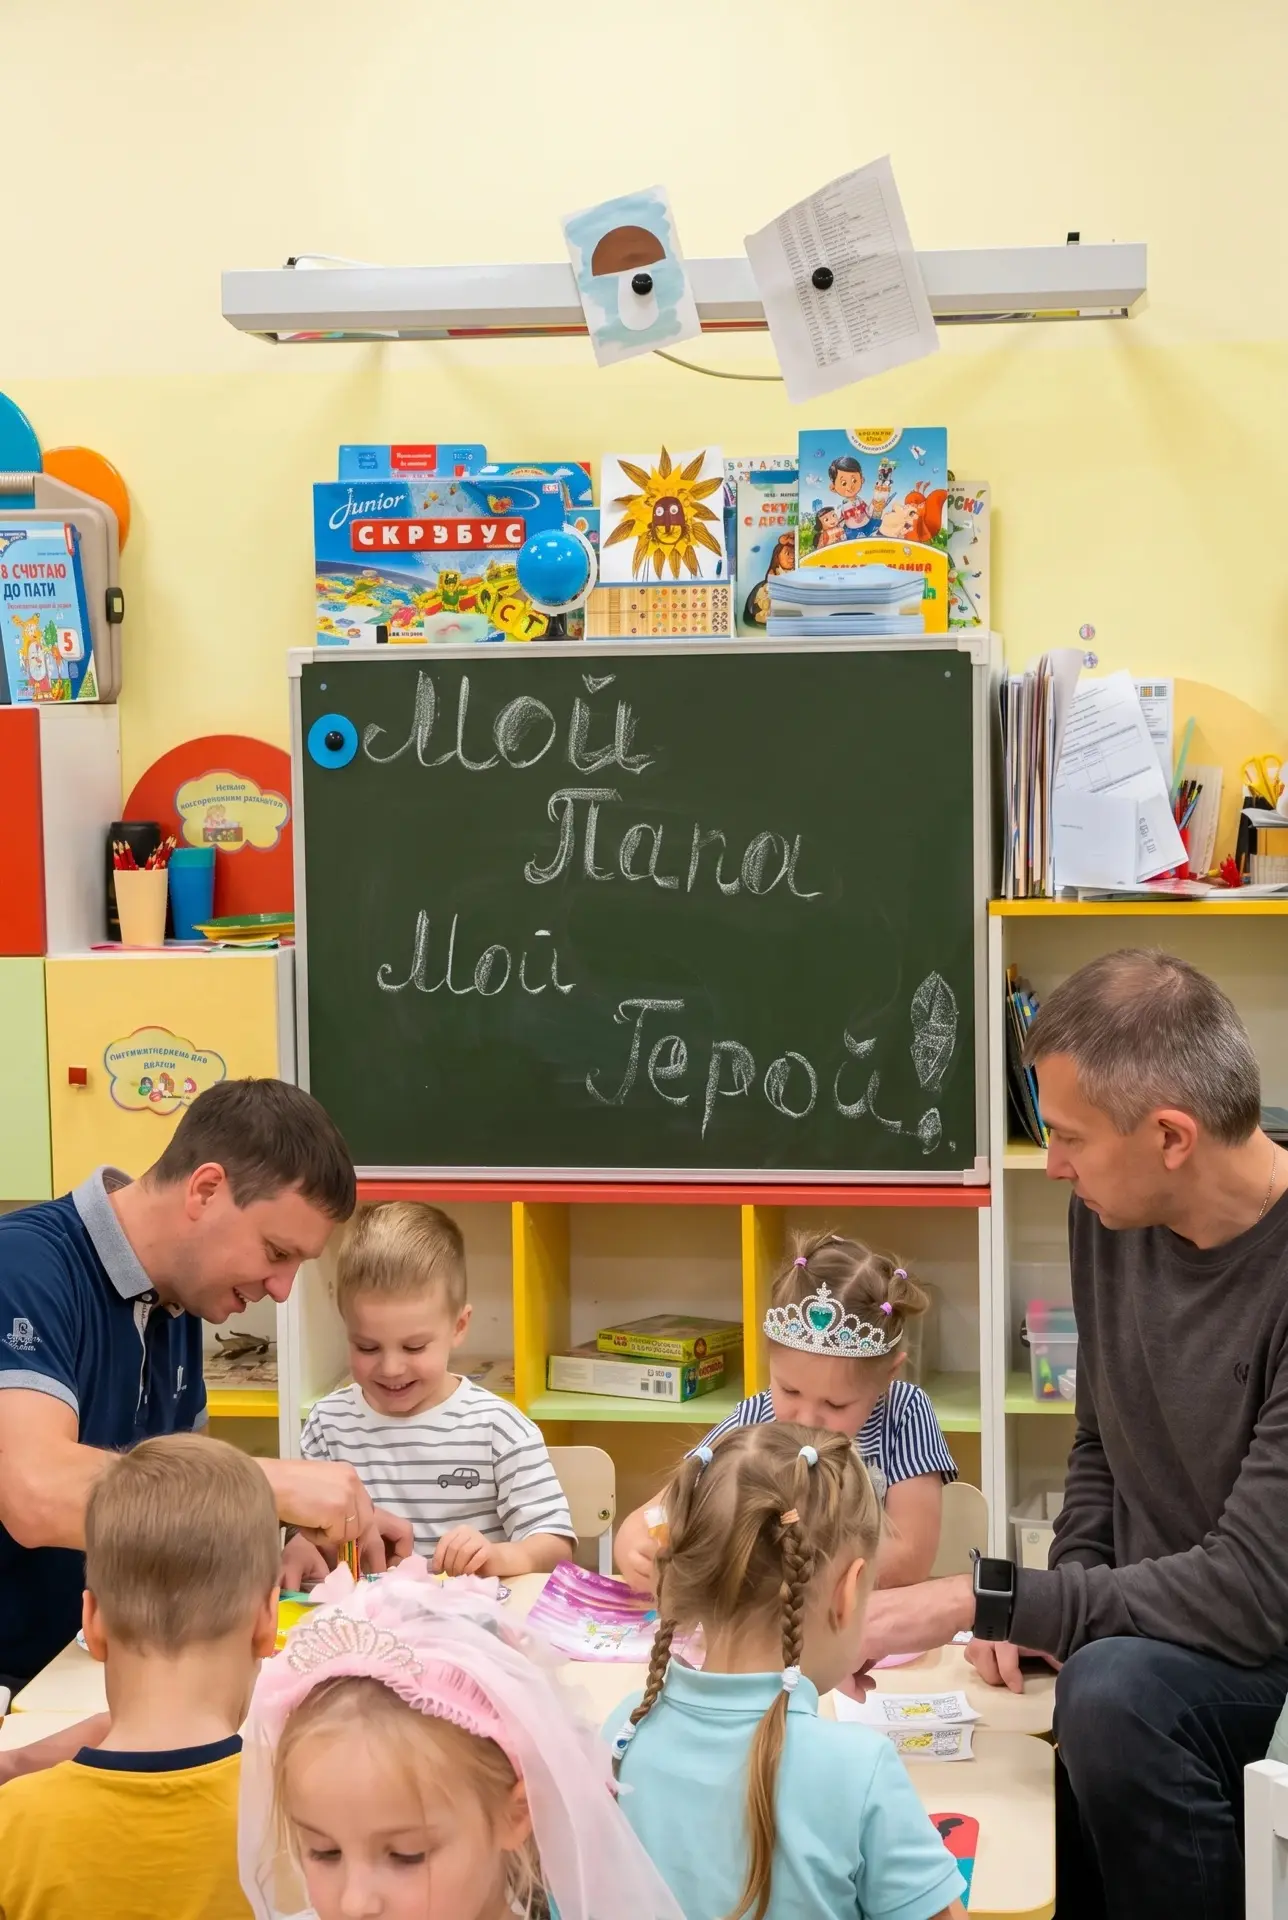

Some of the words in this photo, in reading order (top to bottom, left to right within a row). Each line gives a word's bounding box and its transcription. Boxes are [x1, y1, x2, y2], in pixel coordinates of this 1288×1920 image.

[329, 487, 406, 530] Junior
[4, 582, 21, 601] ДО
[63, 631, 74, 652] 5
[363, 672, 656, 776] Мой
[524, 788, 822, 900] Папа
[377, 909, 576, 996] Мой
